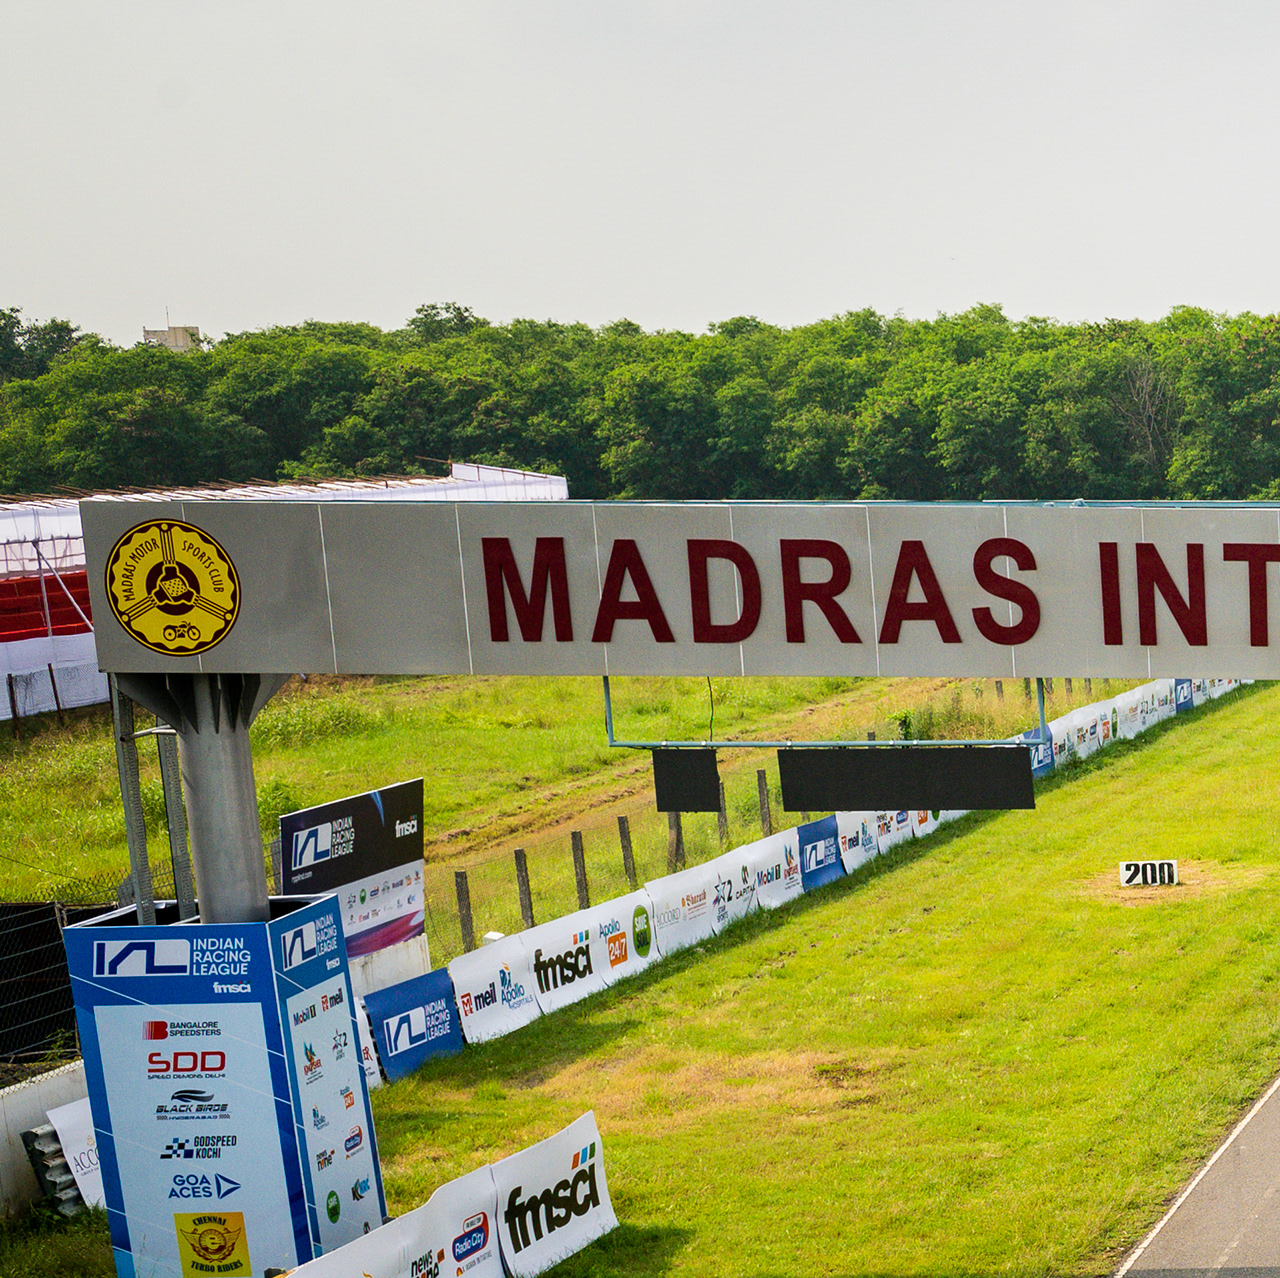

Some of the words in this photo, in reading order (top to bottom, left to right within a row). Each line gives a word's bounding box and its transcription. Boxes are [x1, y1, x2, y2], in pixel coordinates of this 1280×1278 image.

[121, 562, 136, 602] MADRAS
[129, 538, 160, 564] MOTOR
[182, 540, 214, 569] SPORTS
[208, 569, 224, 593] CLUB
[481, 536, 1042, 646] MADRAS
[331, 841, 354, 859] LEAGUE
[1125, 862, 1175, 886] 200
[599, 917, 621, 939] Apollo
[193, 938, 244, 950] INDIAN
[193, 950, 251, 963] RACING
[193, 963, 248, 976] LEAGUE
[533, 944, 593, 994] fmsci
[212, 981, 251, 994] fmsci
[474, 982, 497, 1011] meil
[501, 984, 525, 1008] Apollo
[426, 998, 446, 1015] INDIAN
[169, 1021, 219, 1030] BANGALORE
[426, 1009, 450, 1028] RACING
[169, 1028, 222, 1037] SPEEDSTERS
[427, 1023, 450, 1041] LEAGUE
[147, 1051, 226, 1073] SDD
[193, 1135, 237, 1147] GODSPEED
[195, 1147, 221, 1159] KOCHI
[173, 1174, 211, 1186] GOA
[168, 1185, 213, 1199] ACES
[504, 1163, 600, 1254] fmsci
[192, 1216, 226, 1227] CHENNAI
[191, 1260, 215, 1273] TURBO
[216, 1259, 244, 1273] RIDERS
[411, 1250, 432, 1277] news
